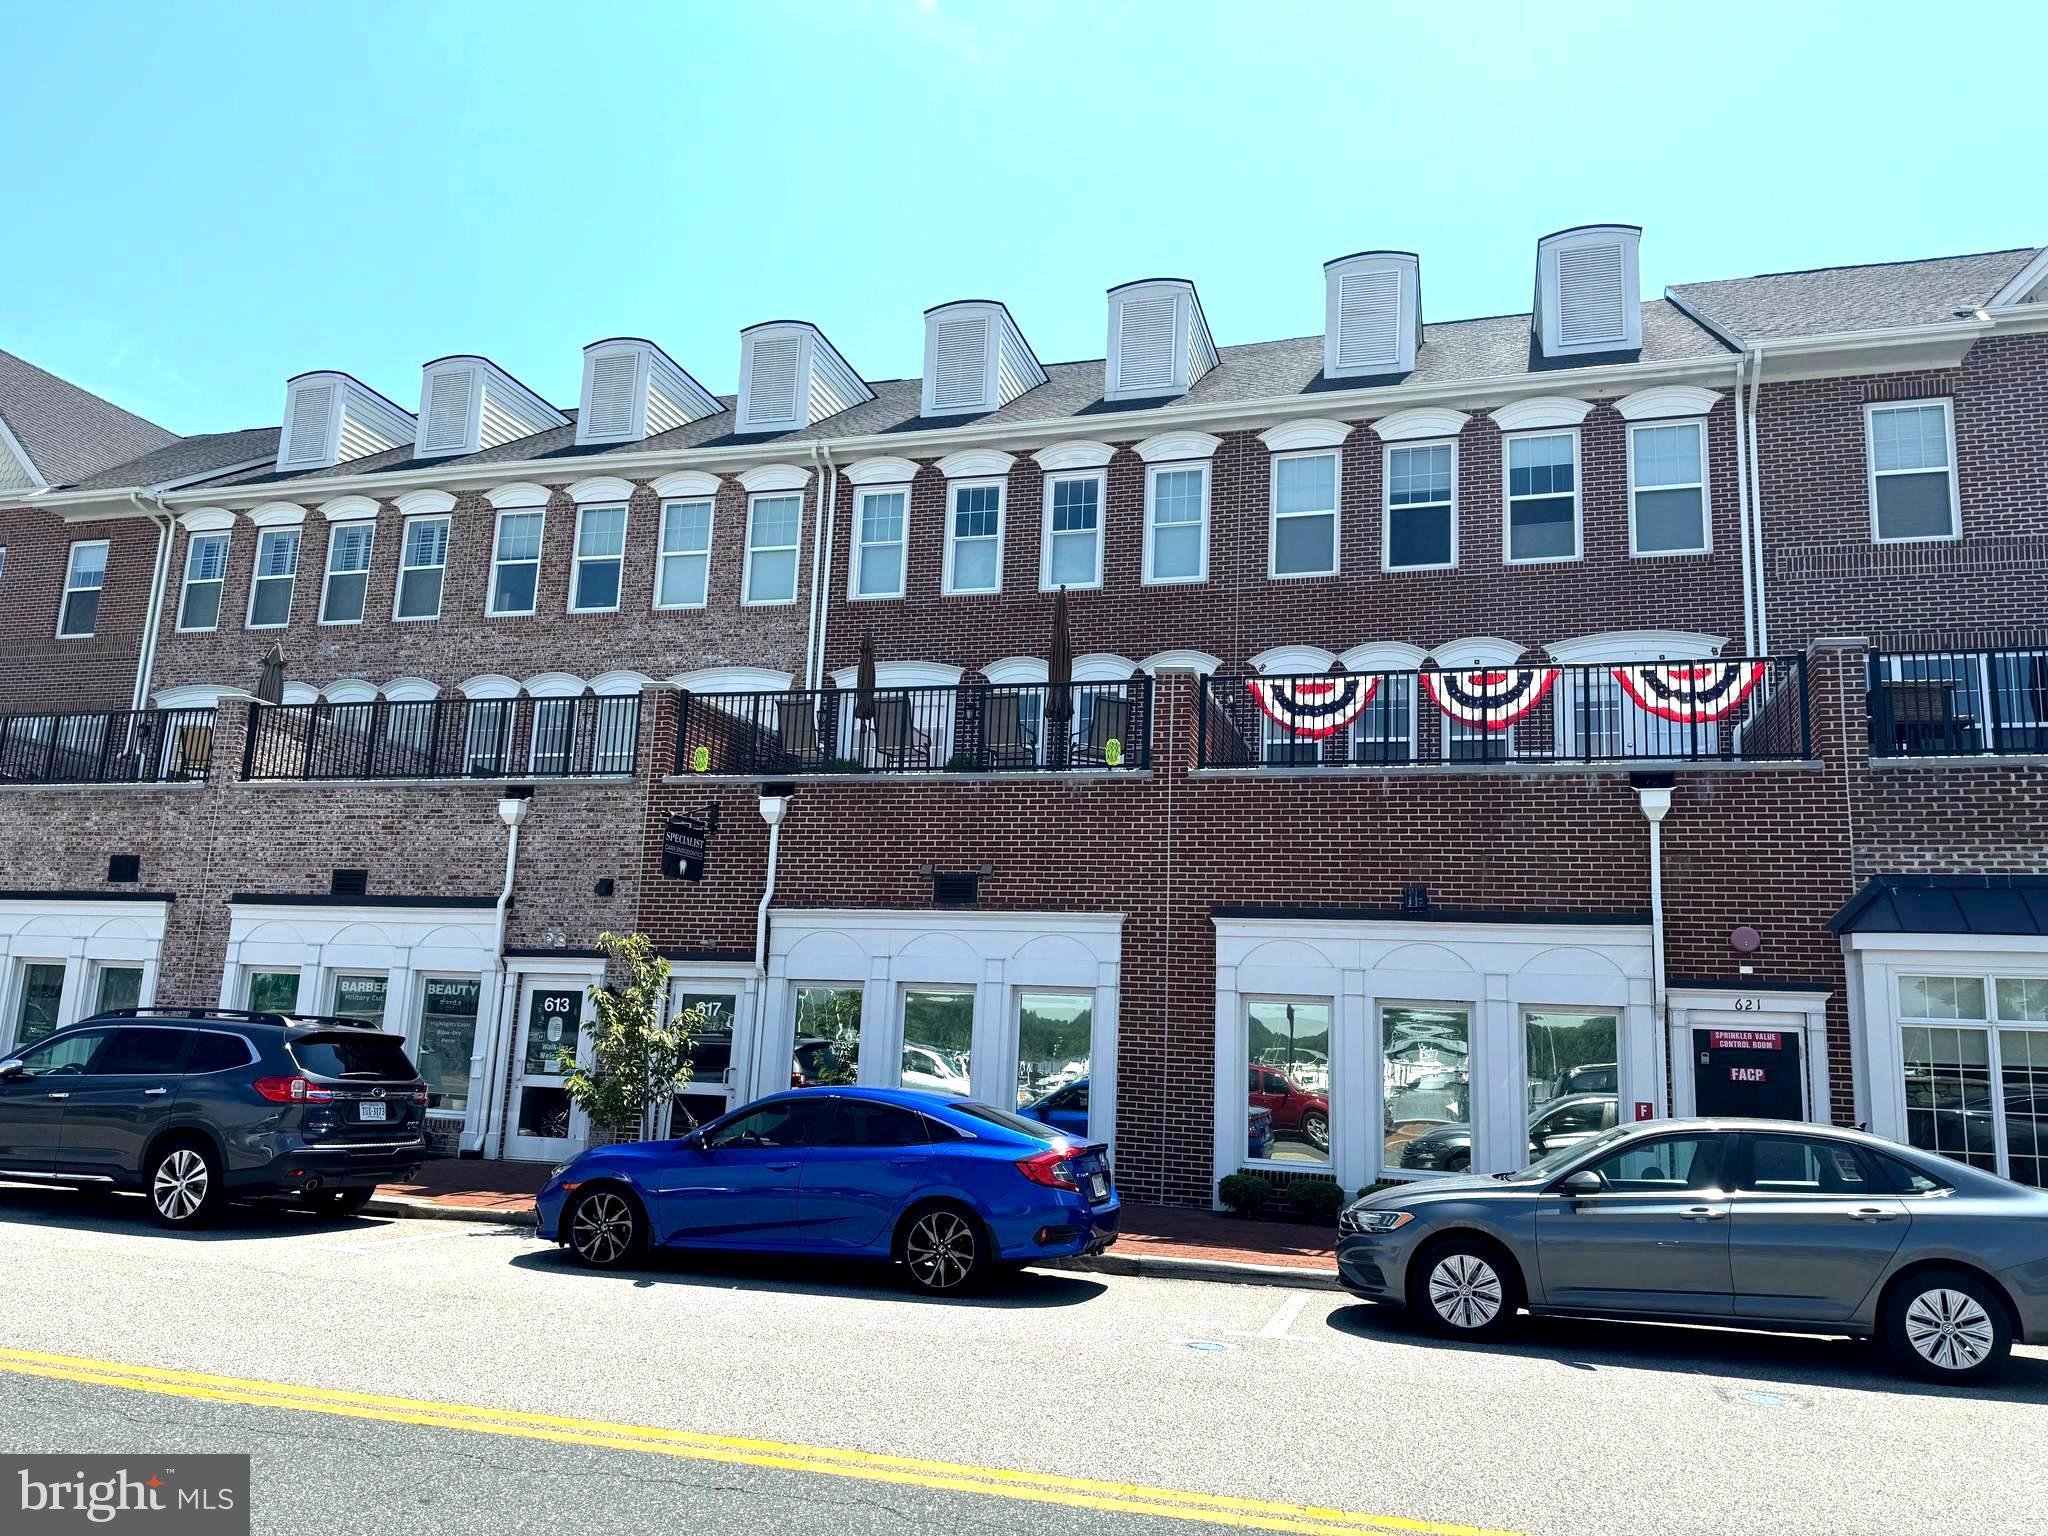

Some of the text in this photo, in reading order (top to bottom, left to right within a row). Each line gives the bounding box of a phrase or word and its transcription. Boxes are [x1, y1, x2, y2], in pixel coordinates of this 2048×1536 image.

[665, 831, 705, 849] SPECIALIST
[427, 984, 478, 996] BEAUTY
[344, 993, 370, 1003] Military
[544, 997, 570, 1012] 613
[695, 1001, 722, 1016] 617
[1735, 998, 1761, 1012] 621
[1715, 1031, 1752, 1040] SPRINKLER
[1719, 1040, 1773, 1049] CONTROL ROOM
[1731, 1068, 1764, 1081] FACP
[1640, 1105, 1647, 1117] F
